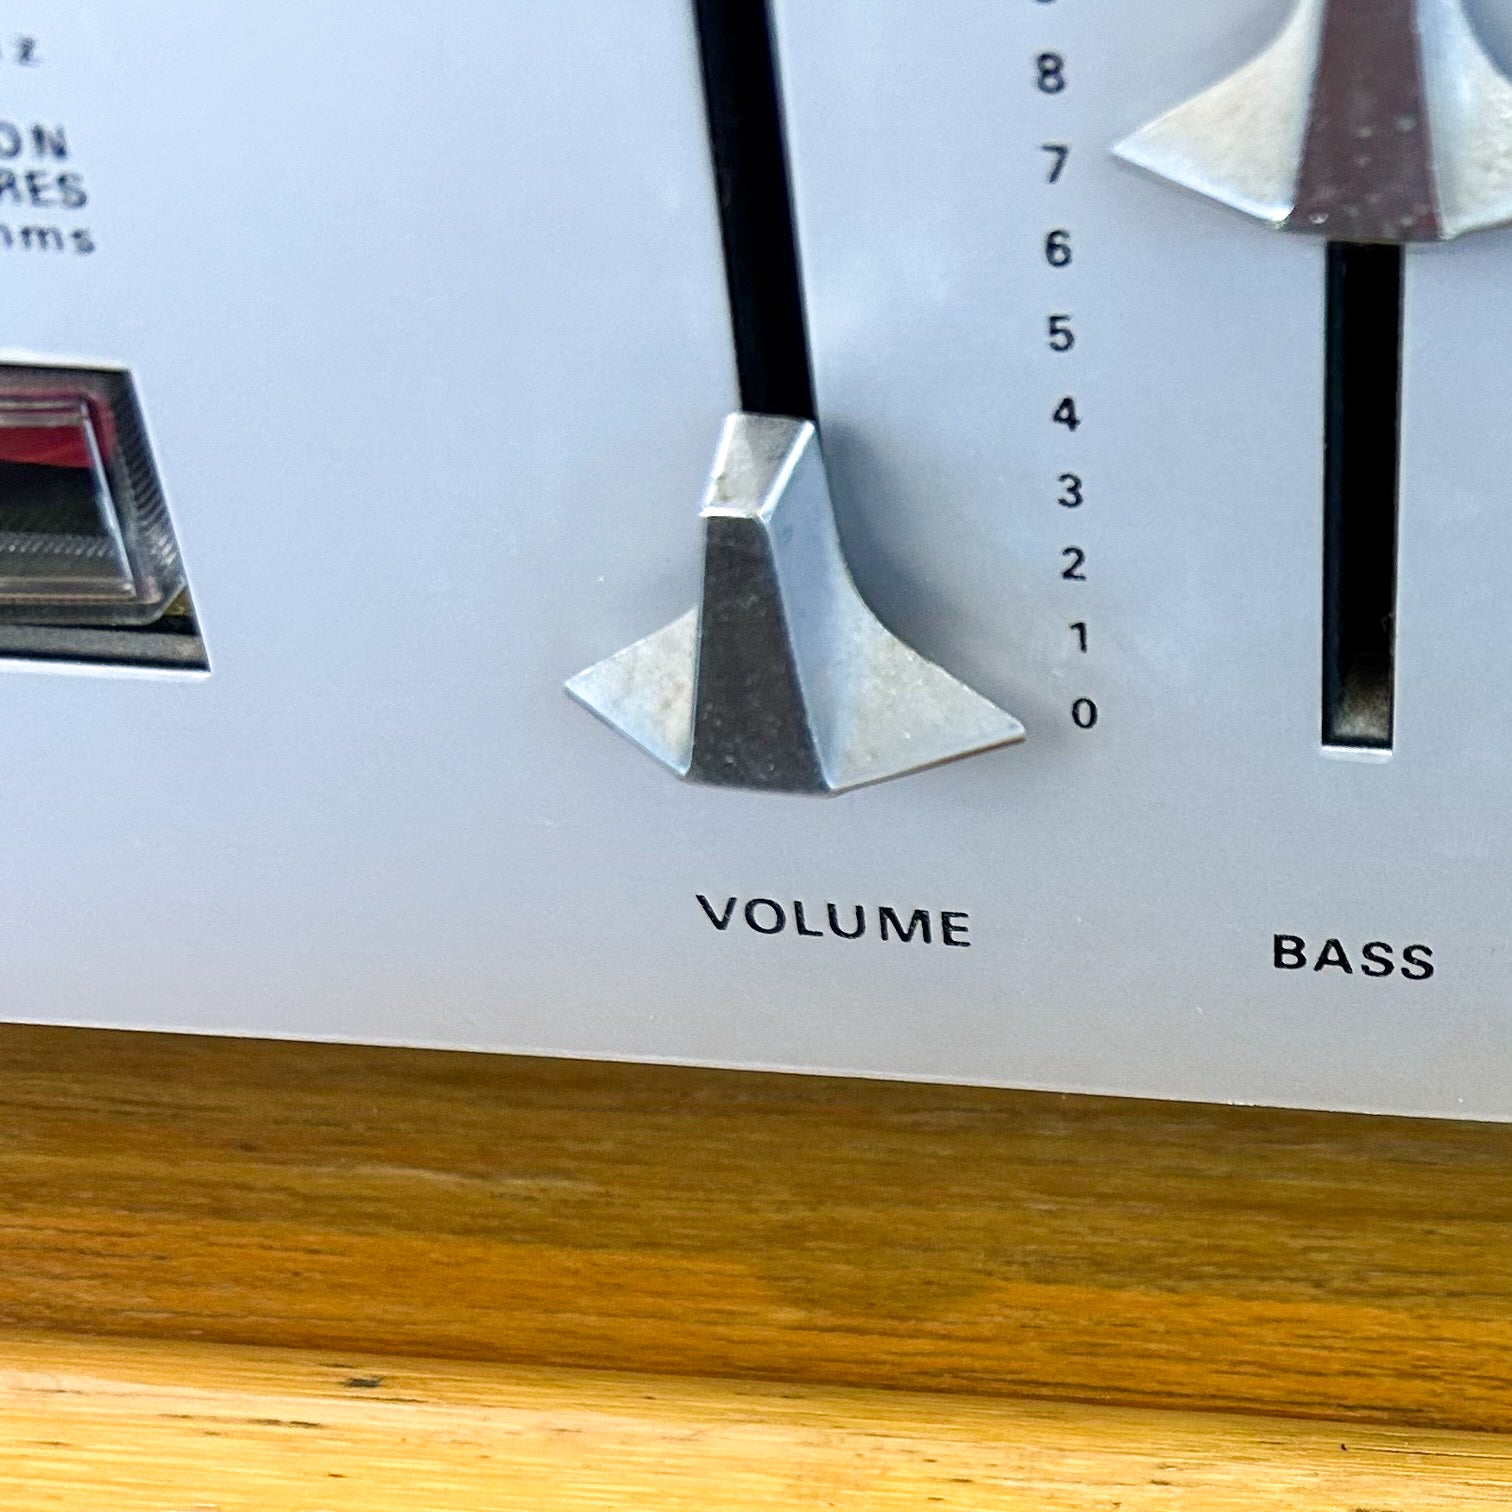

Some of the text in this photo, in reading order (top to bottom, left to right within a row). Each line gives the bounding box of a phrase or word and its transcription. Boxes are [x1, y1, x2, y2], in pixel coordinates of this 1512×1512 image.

[1035, 51, 1067, 95] 8
[1040, 143, 1070, 185] 7
[1043, 229, 1073, 269] 6
[1047, 314, 1076, 353] 5
[1051, 396, 1082, 433] 4
[1057, 472, 1085, 509] 3
[1060, 545, 1087, 582] 2
[1069, 621, 1088, 654] 1
[1070, 697, 1099, 730] 0
[694, 893, 973, 949] VOLUME
[1272, 932, 1436, 982] BASS
